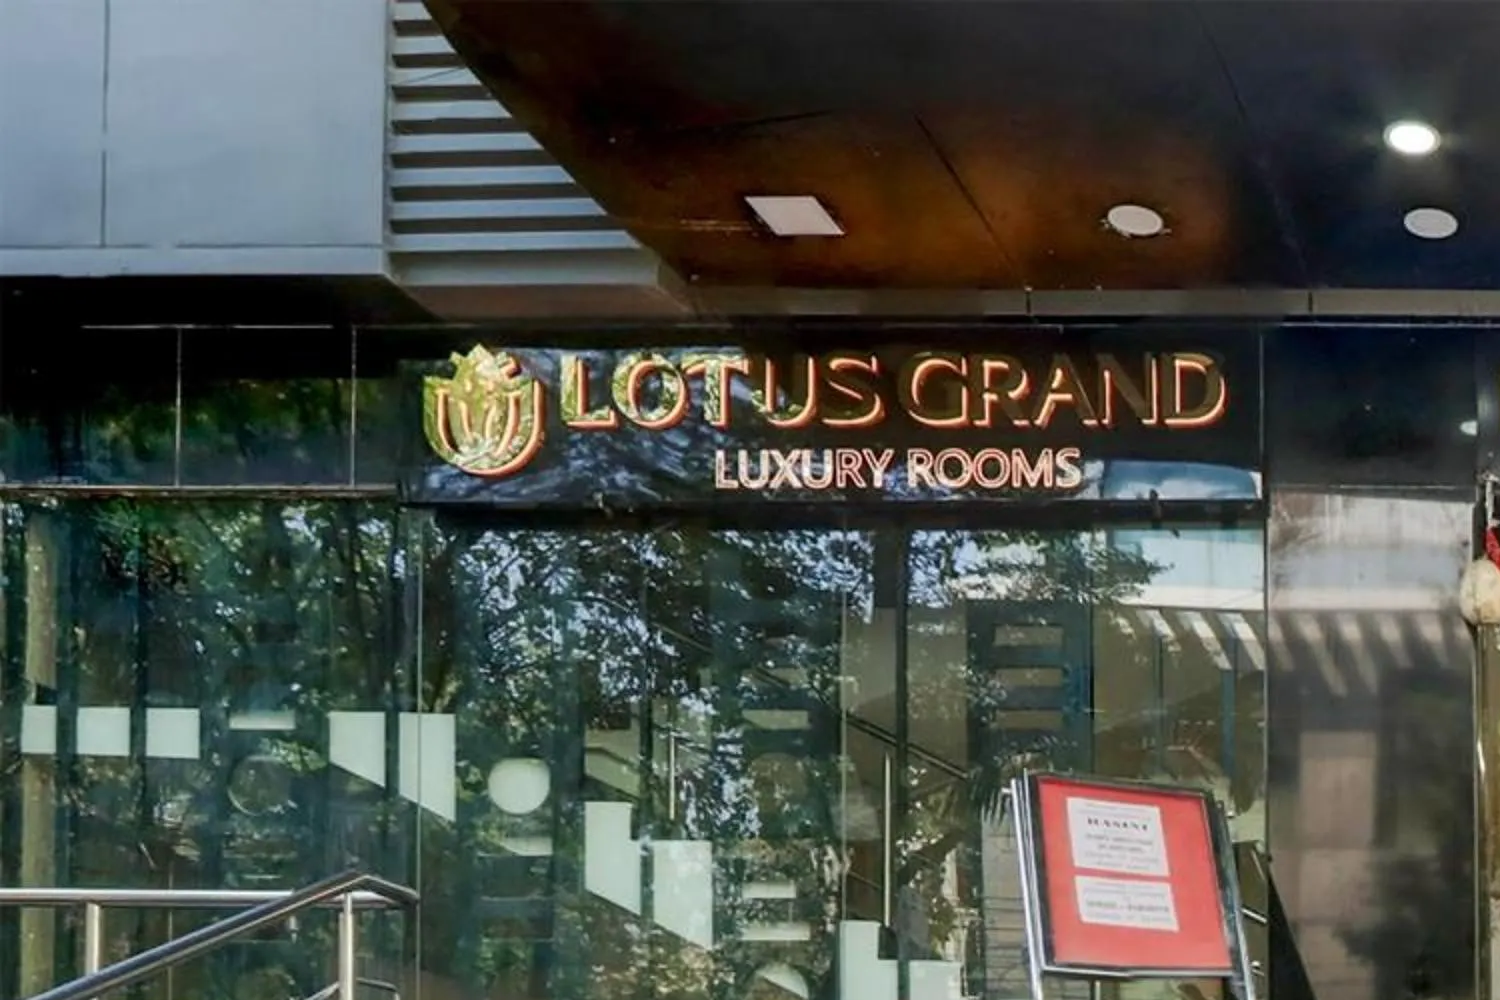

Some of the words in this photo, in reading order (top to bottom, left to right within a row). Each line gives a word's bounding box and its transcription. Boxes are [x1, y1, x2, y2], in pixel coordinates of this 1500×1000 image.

[560, 352, 886, 431] LOTUS
[903, 352, 1226, 430] GRAND
[715, 449, 895, 489] LUXURY
[907, 448, 1081, 489] ROOMS
